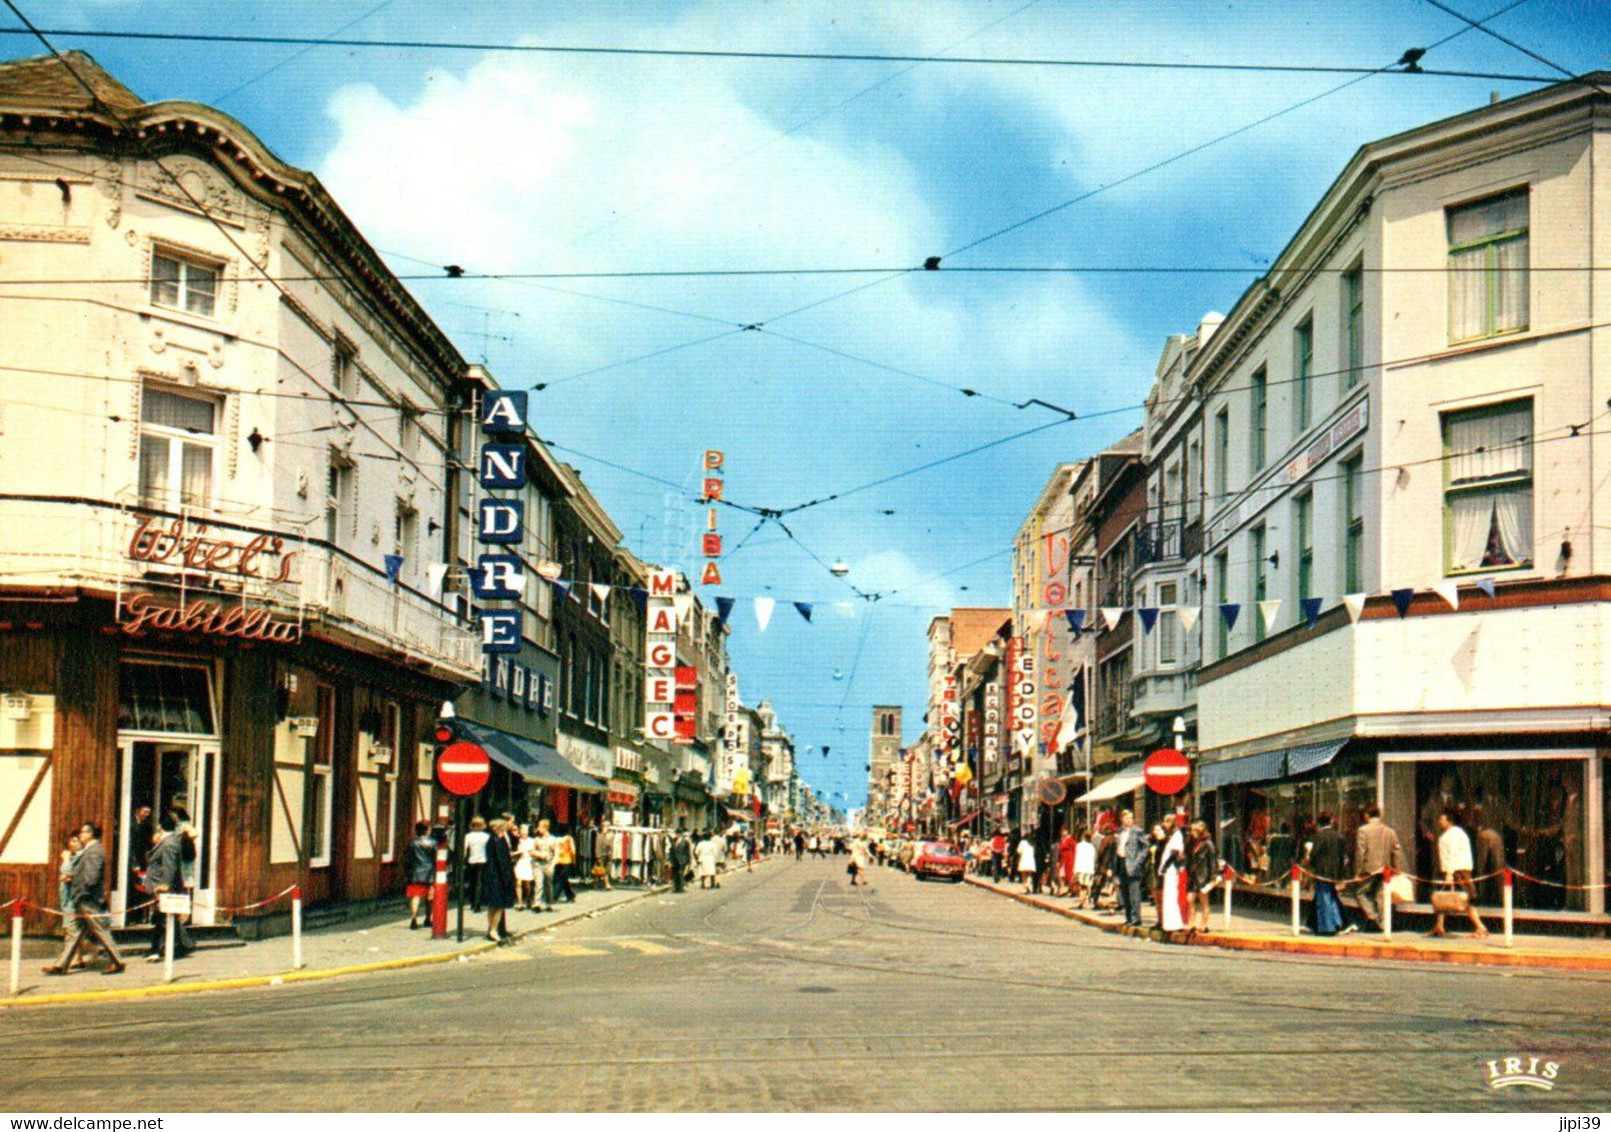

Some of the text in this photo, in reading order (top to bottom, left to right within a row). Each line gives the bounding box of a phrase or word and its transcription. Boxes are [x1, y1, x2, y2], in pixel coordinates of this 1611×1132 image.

[484, 396, 524, 645] ANDRE
[701, 449, 724, 586] PRIBA
[651, 574, 674, 737] MAGEC
